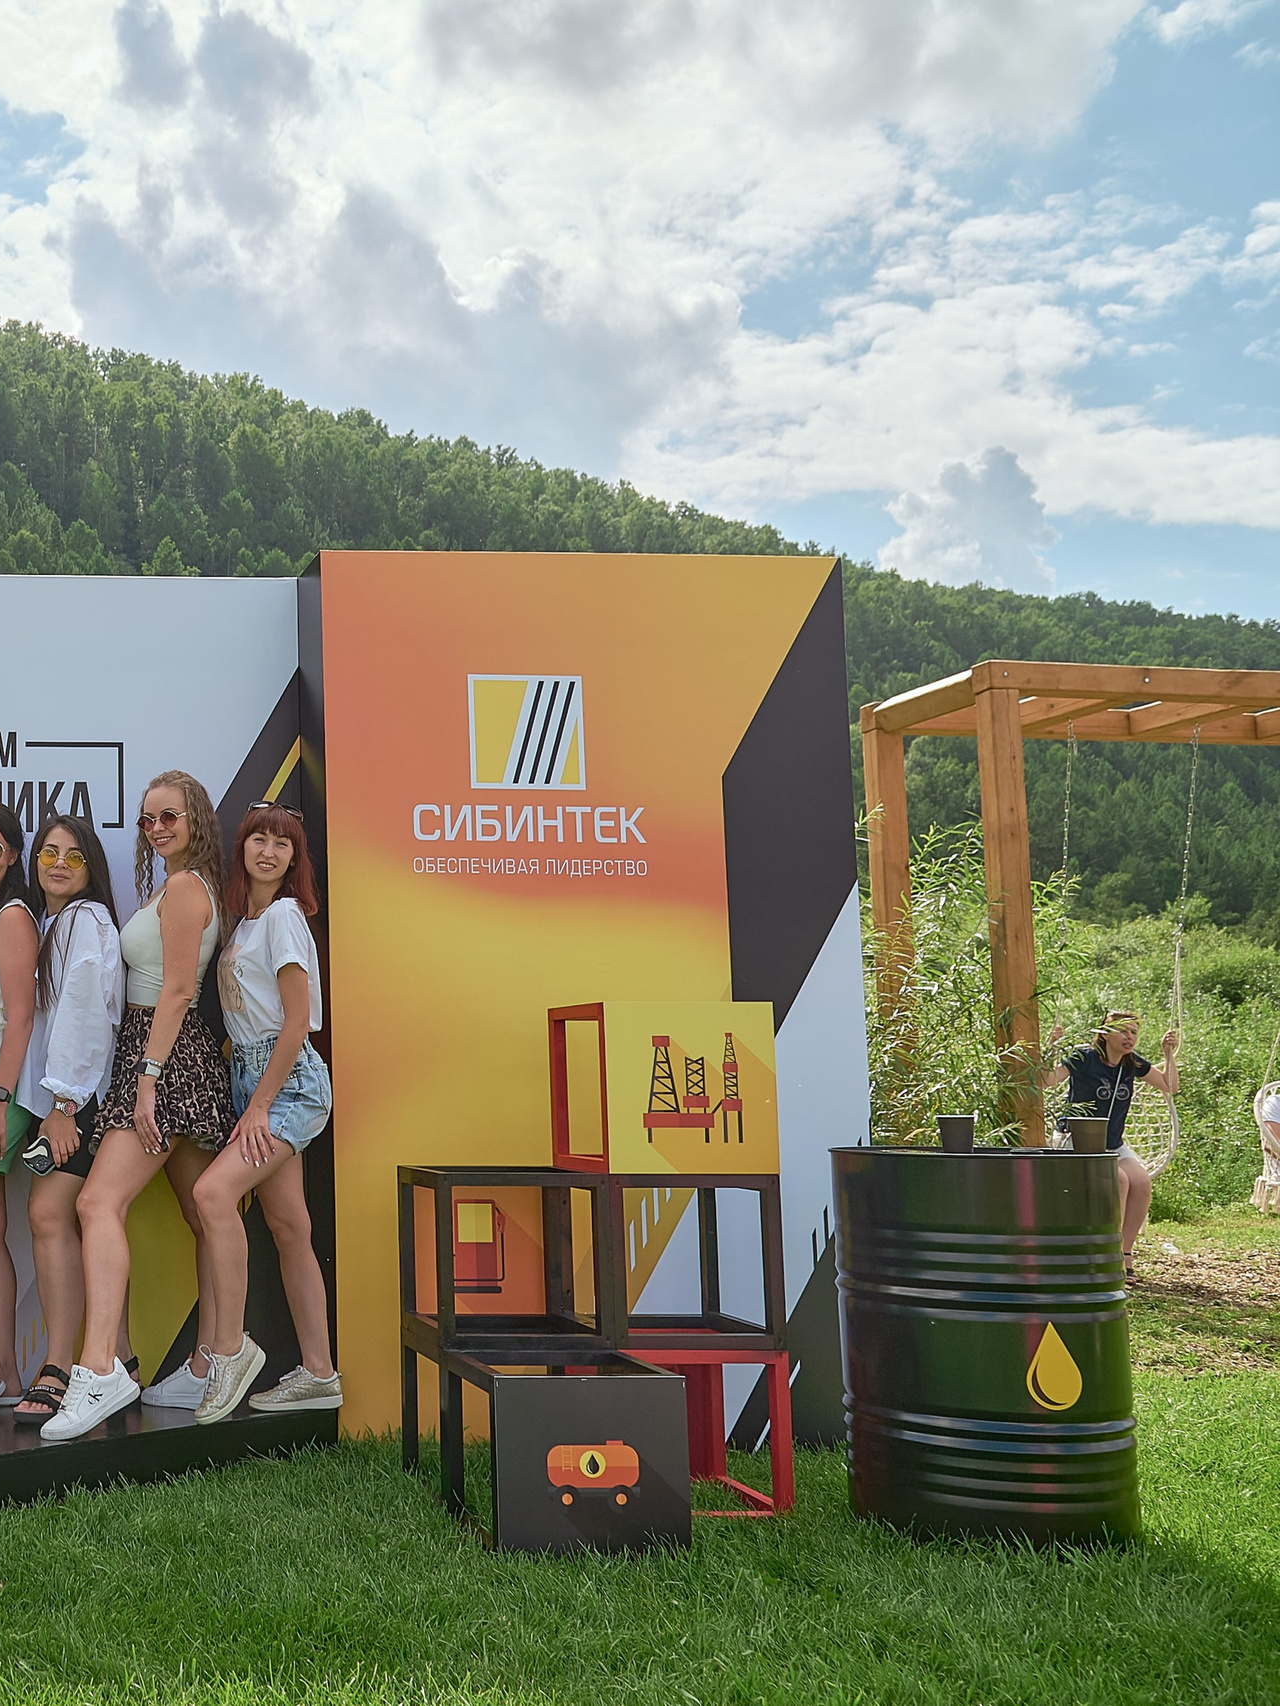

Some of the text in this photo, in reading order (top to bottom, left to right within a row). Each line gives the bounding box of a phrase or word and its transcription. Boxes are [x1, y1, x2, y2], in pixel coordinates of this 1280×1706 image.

[413, 804, 648, 844] СИБИНТЕК
[413, 857, 648, 878] ОБЕСПЕЧИВАЯ ЛИДЕРСТВО
